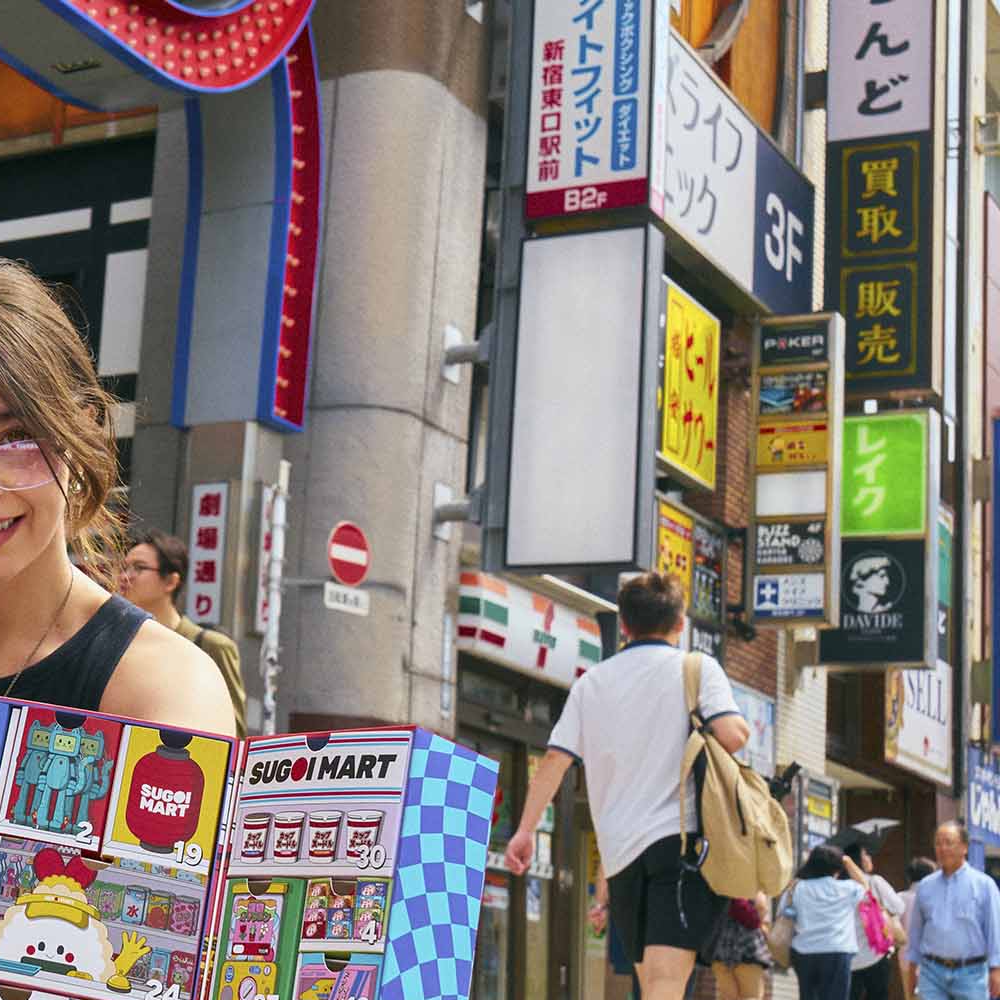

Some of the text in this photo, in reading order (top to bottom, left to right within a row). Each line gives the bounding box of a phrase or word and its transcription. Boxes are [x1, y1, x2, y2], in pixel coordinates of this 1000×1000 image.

[855, 0, 910, 116] んど
[571, 0, 604, 177] イトフィット
[538, 39, 566, 183] 新宿東口駅前
[564, 188, 607, 212] B2F
[856, 158, 902, 243] 買取
[764, 192, 804, 282] 3F
[856, 280, 902, 366] 販売
[764, 334, 825, 350] POKER
[853, 425, 887, 517] レイク
[194, 491, 222, 617] 劇場通り
[843, 613, 903, 629] DAVIDE
[249, 754, 397, 785] SUGOI MART
[139, 797, 190, 817] MART
[140, 784, 192, 804] SUGOI
[75, 821, 94, 845] 2
[173, 841, 203, 867] 19
[357, 845, 387, 869] 30
[361, 920, 378, 945] 4
